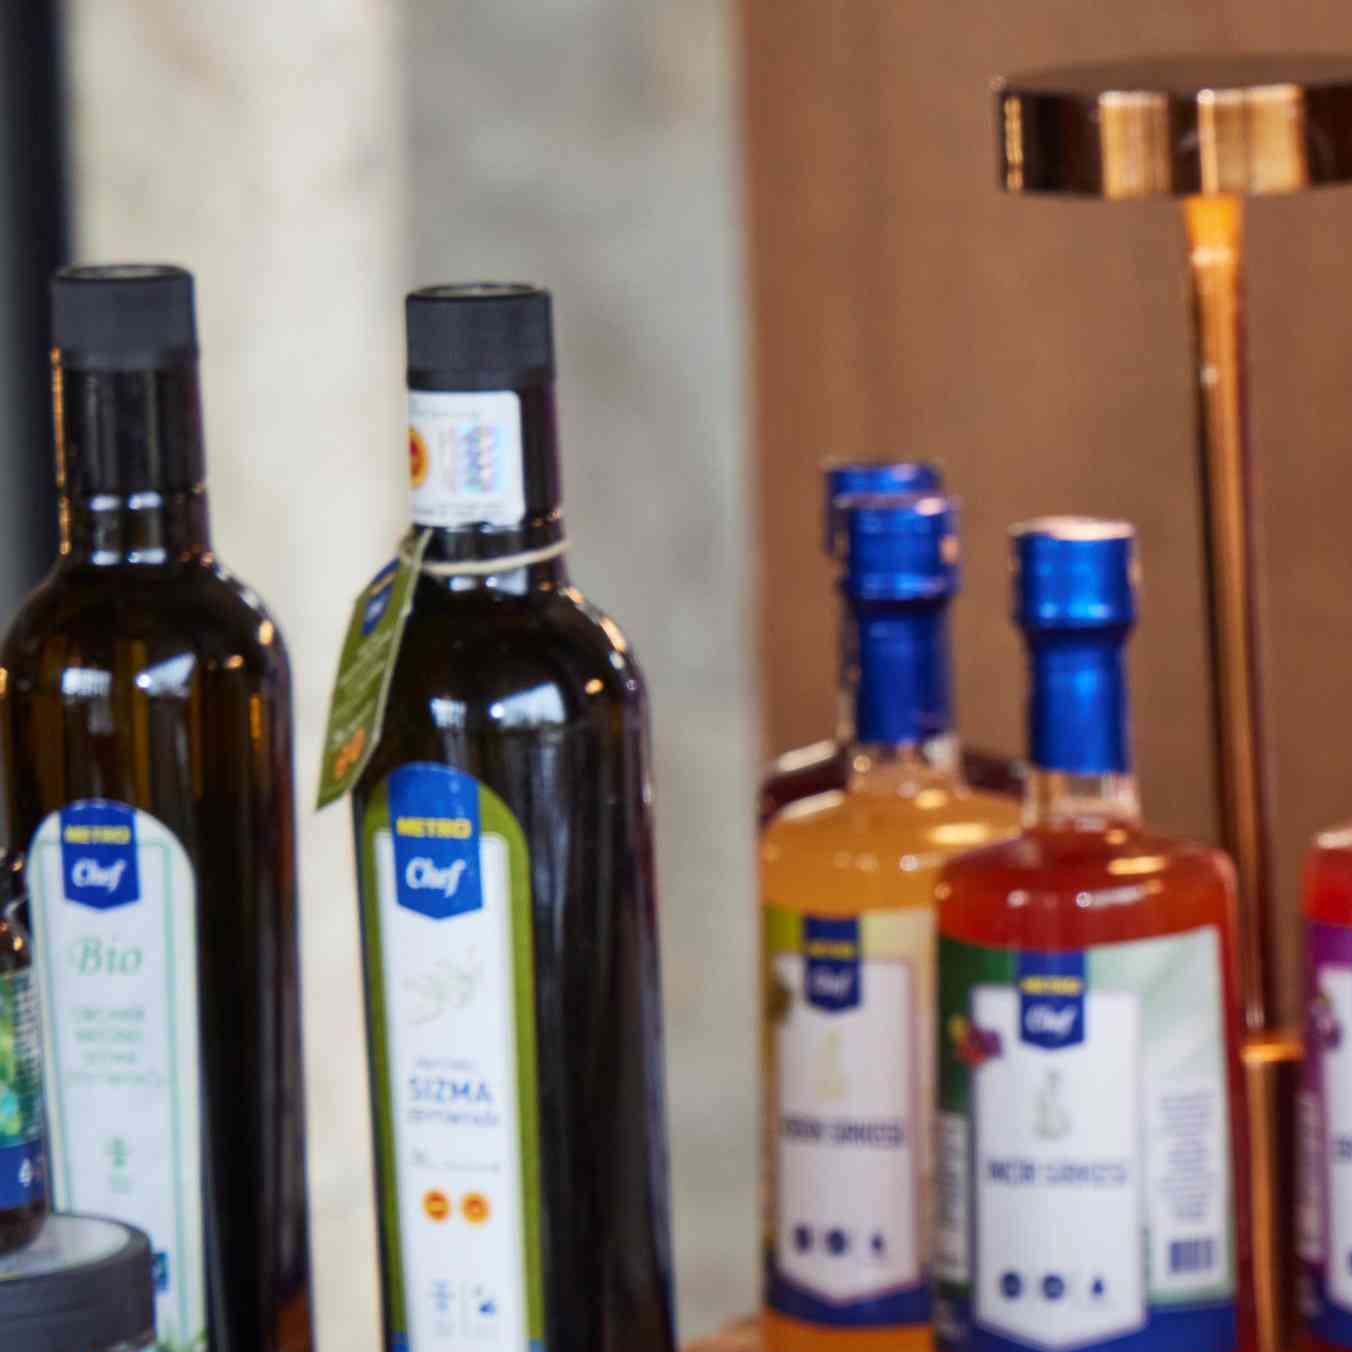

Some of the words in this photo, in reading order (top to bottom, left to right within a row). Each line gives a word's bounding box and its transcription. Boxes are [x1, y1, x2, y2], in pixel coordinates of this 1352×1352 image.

[71, 857, 126, 892] Chef
[405, 857, 466, 897] Chef
[69, 936, 144, 977] Bio
